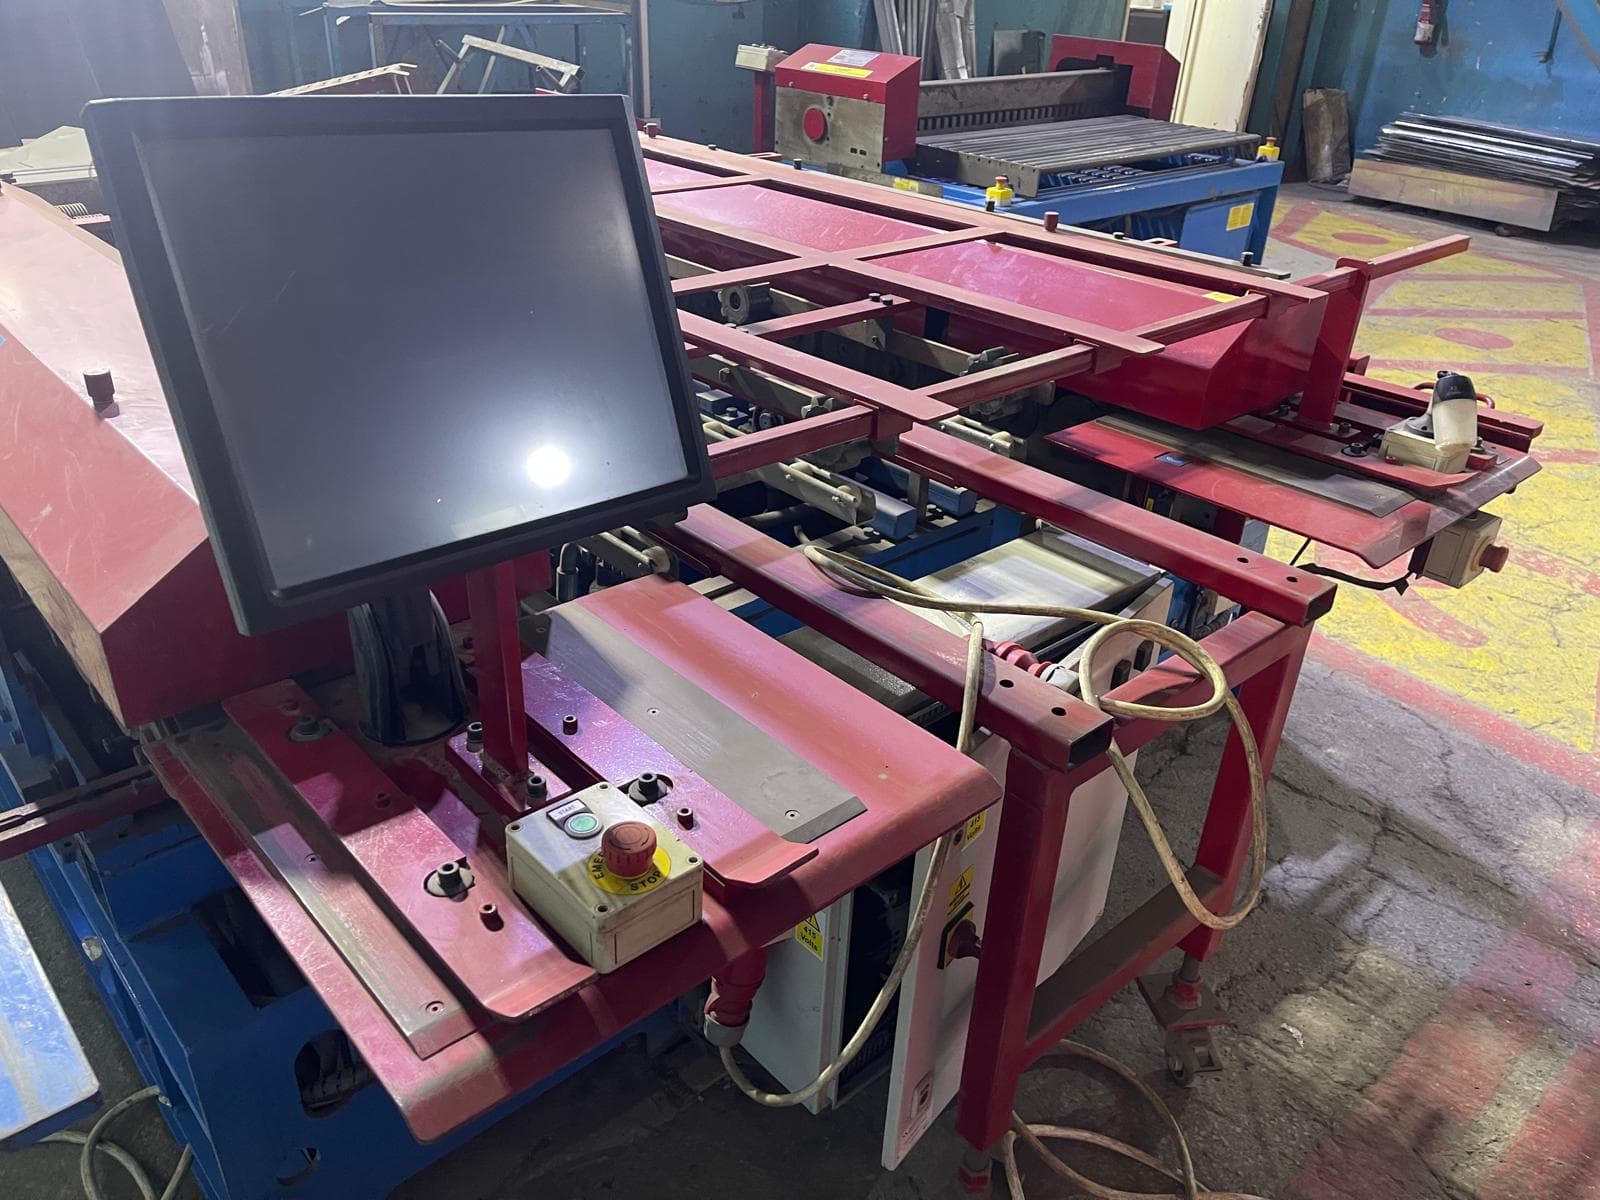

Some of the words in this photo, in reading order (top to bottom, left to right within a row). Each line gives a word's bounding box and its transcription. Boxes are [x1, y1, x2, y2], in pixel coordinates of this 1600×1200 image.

[630, 870, 662, 891] STOP
[800, 931, 818, 952] Volts
[803, 926, 817, 940] 415
